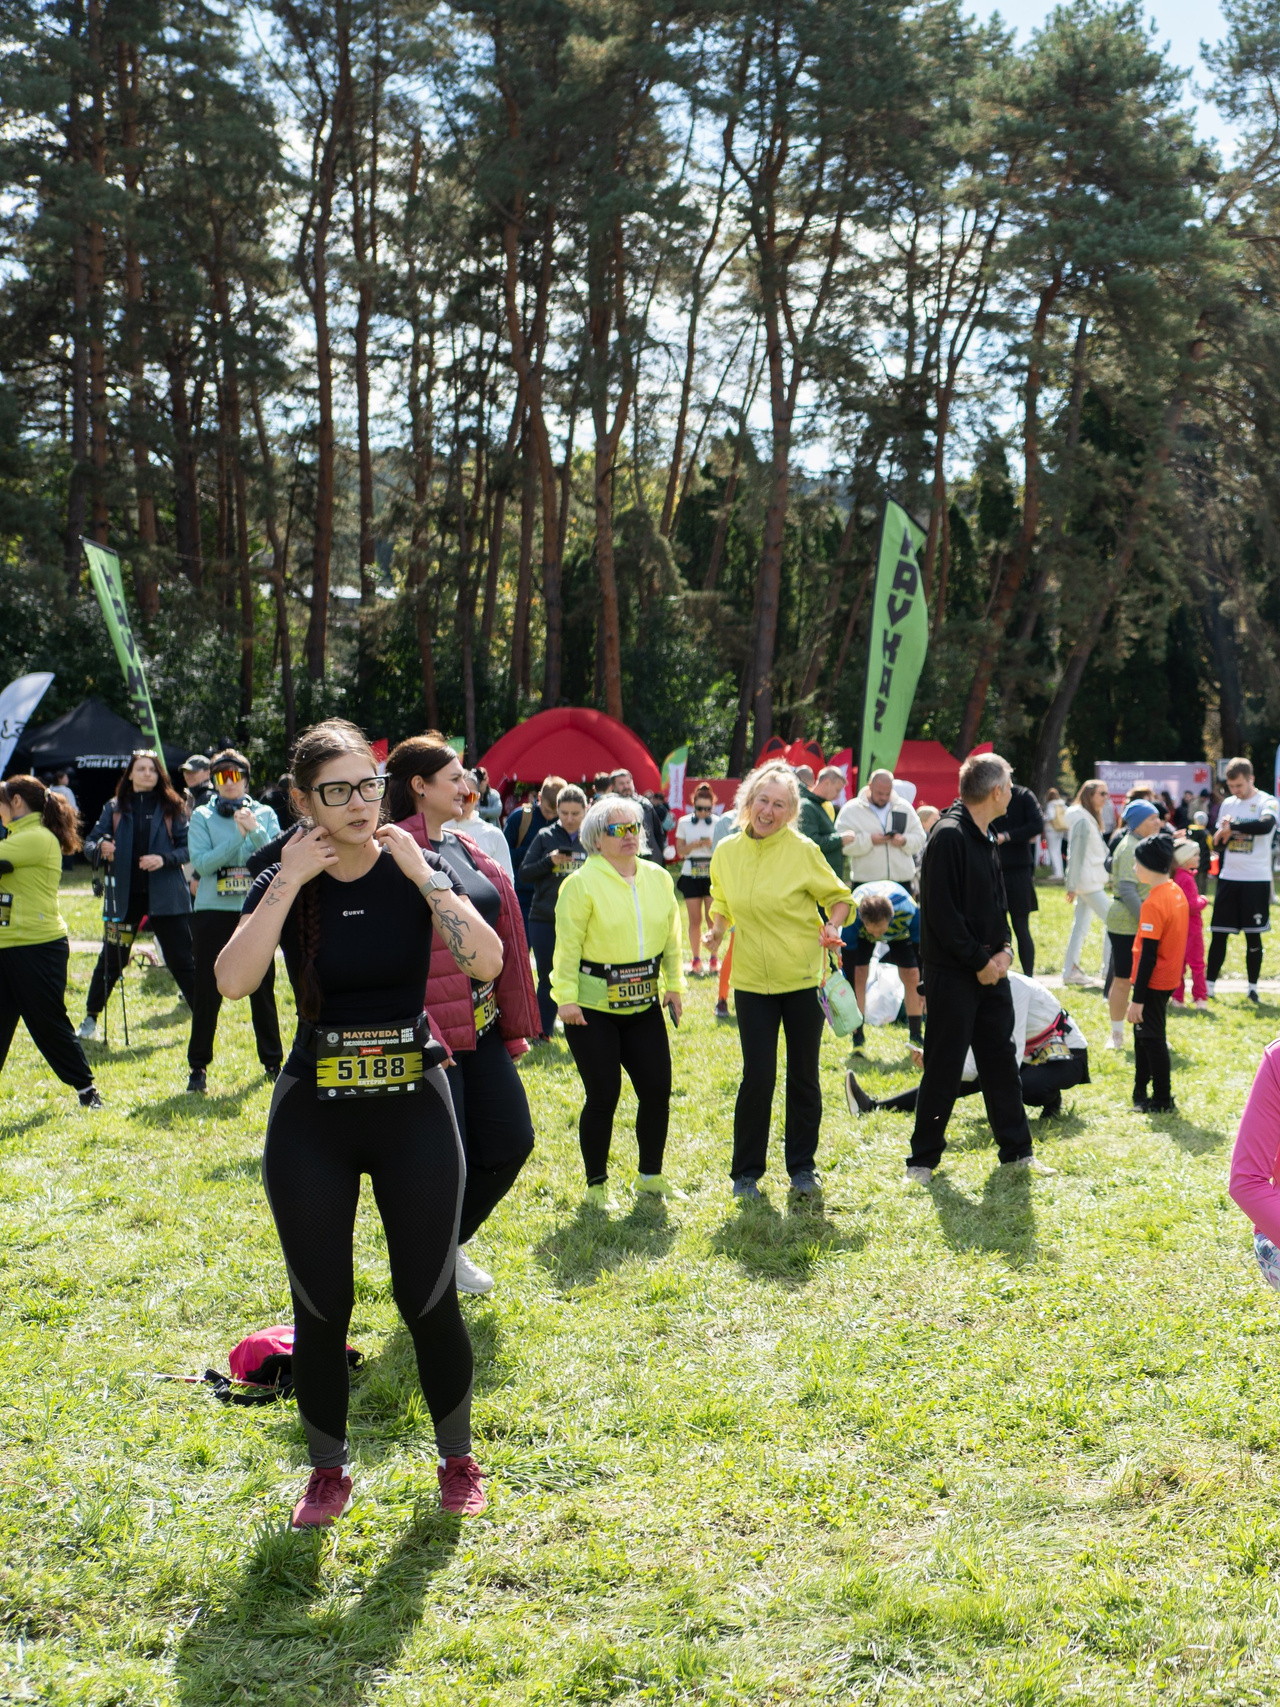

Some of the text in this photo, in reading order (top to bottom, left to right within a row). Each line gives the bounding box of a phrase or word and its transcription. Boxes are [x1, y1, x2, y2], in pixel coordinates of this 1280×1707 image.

[618, 982, 652, 998] 5009
[343, 1029, 399, 1039] MAYRVEDA
[337, 1056, 405, 1081] 5188
